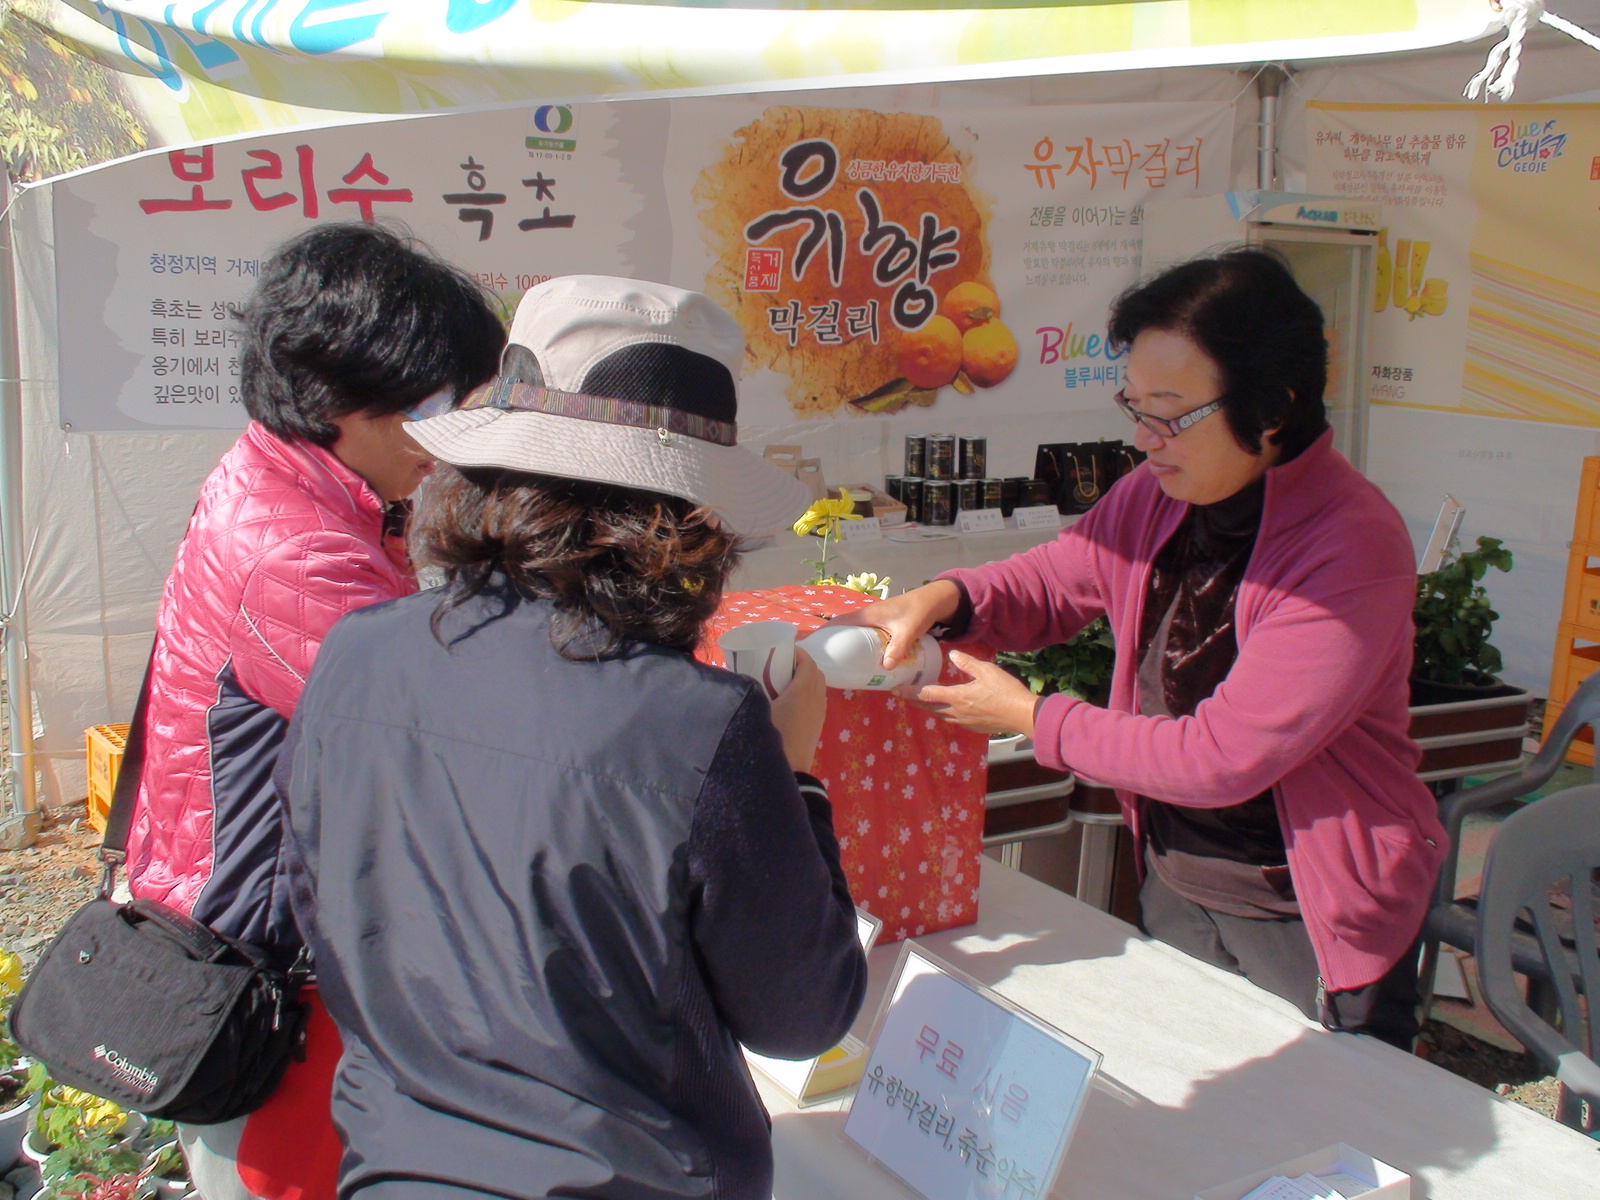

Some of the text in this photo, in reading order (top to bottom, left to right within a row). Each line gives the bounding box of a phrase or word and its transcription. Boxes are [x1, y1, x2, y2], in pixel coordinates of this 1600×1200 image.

[1490, 120, 1541, 148] Blue
[1023, 136, 1203, 191] 유자막걸리
[1497, 140, 1540, 168] City
[1513, 162, 1547, 173] GEOJE
[138, 145, 413, 225] 보리수
[1029, 206, 1066, 227] 전통을
[1072, 206, 1126, 227] 이어가는
[150, 253, 217, 275] 청정지역
[151, 298, 202, 320] 흑초는
[768, 300, 879, 345] 막걸리
[151, 328, 186, 348] 특히
[1035, 322, 1102, 365] Blue
[152, 356, 220, 377] 옹기에서
[1064, 365, 1119, 389] 블루씨티
[154, 385, 220, 405] 깊은맛이
[104, 1049, 159, 1086] Columbia
[915, 1024, 1030, 1124] 무료 시음
[110, 1068, 155, 1094] TITANIUM
